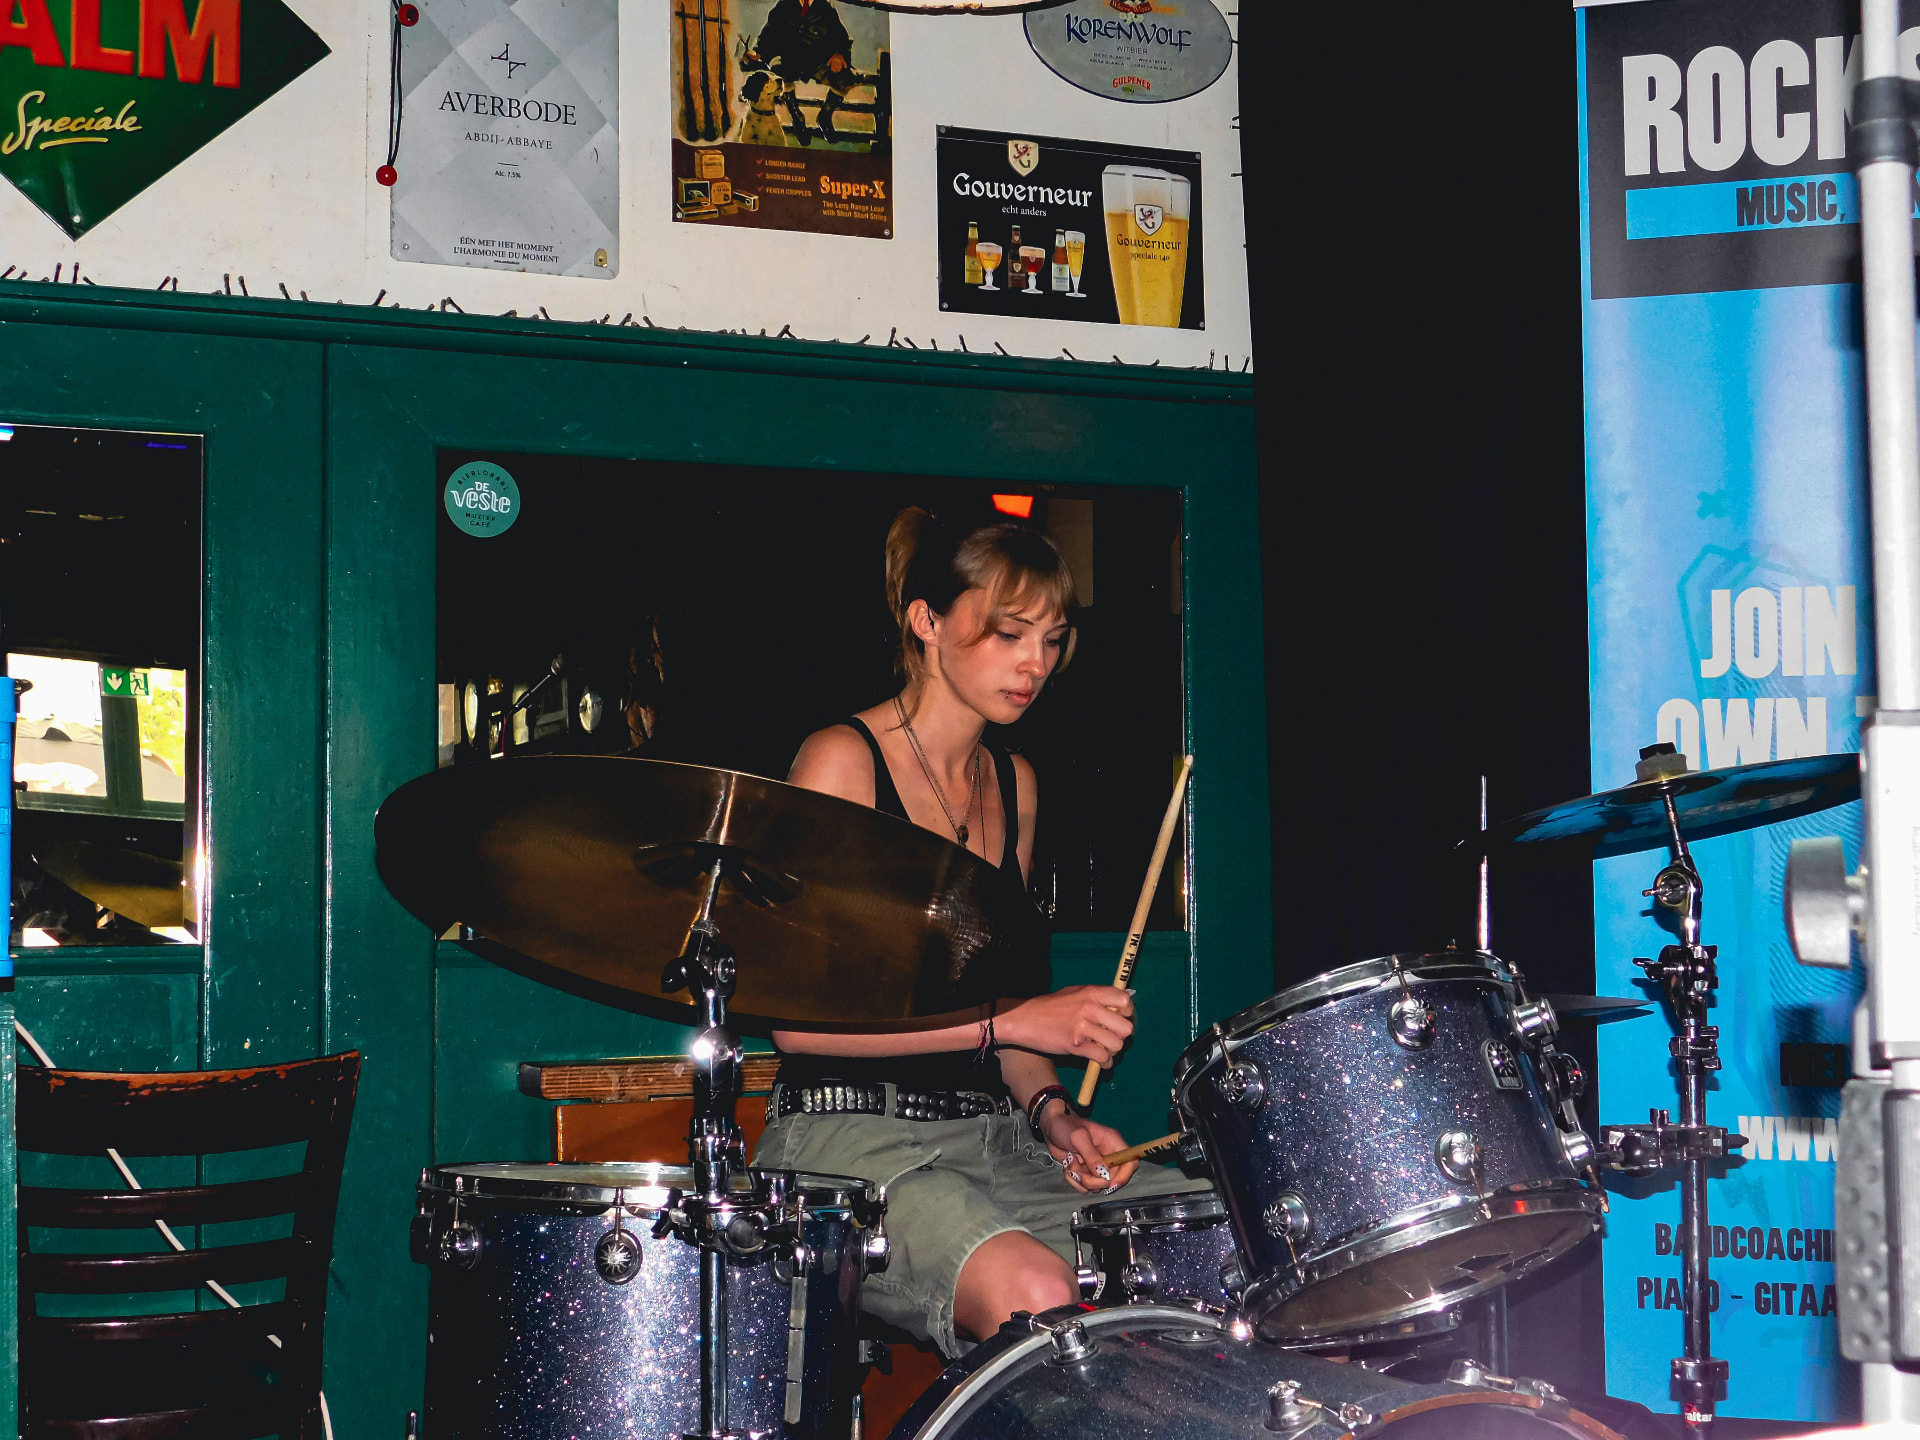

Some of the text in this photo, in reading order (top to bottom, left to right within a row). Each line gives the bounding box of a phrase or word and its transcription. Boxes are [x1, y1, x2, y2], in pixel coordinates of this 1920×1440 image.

[1065, 12, 1192, 53] KORENWOLF
[1116, 45, 1148, 55] WITBIER
[1112, 75, 1152, 92] GULPENER
[438, 90, 577, 125] AVERBODE
[1622, 27, 1920, 176] ROCK
[2, 90, 142, 155] Speciale
[819, 175, 886, 199] Super-X
[953, 172, 1093, 207] Gouverneur
[822, 209, 836, 217] with
[834, 201, 849, 211] Long
[850, 202, 869, 212] Range
[1001, 204, 1047, 217] echt anders
[1735, 180, 1845, 227] MUSIC,
[453, 246, 506, 258] L'HARMONIE
[508, 251, 521, 259] DU
[522, 253, 560, 263] MOMENT
[478, 238, 496, 248] MET
[498, 240, 515, 250] HET
[516, 242, 555, 253] MOMENT
[1116, 233, 1182, 250] Gouverneur
[449, 487, 511, 514] Veste
[474, 481, 491, 493] DE
[1700, 585, 1857, 679] JOIN
[1656, 696, 1828, 772] OWN
[1119, 933, 1141, 982] VIC FIRTH
[1655, 1223, 1837, 1262] BADCOACHI
[1636, 1276, 1720, 1313] PIAO
